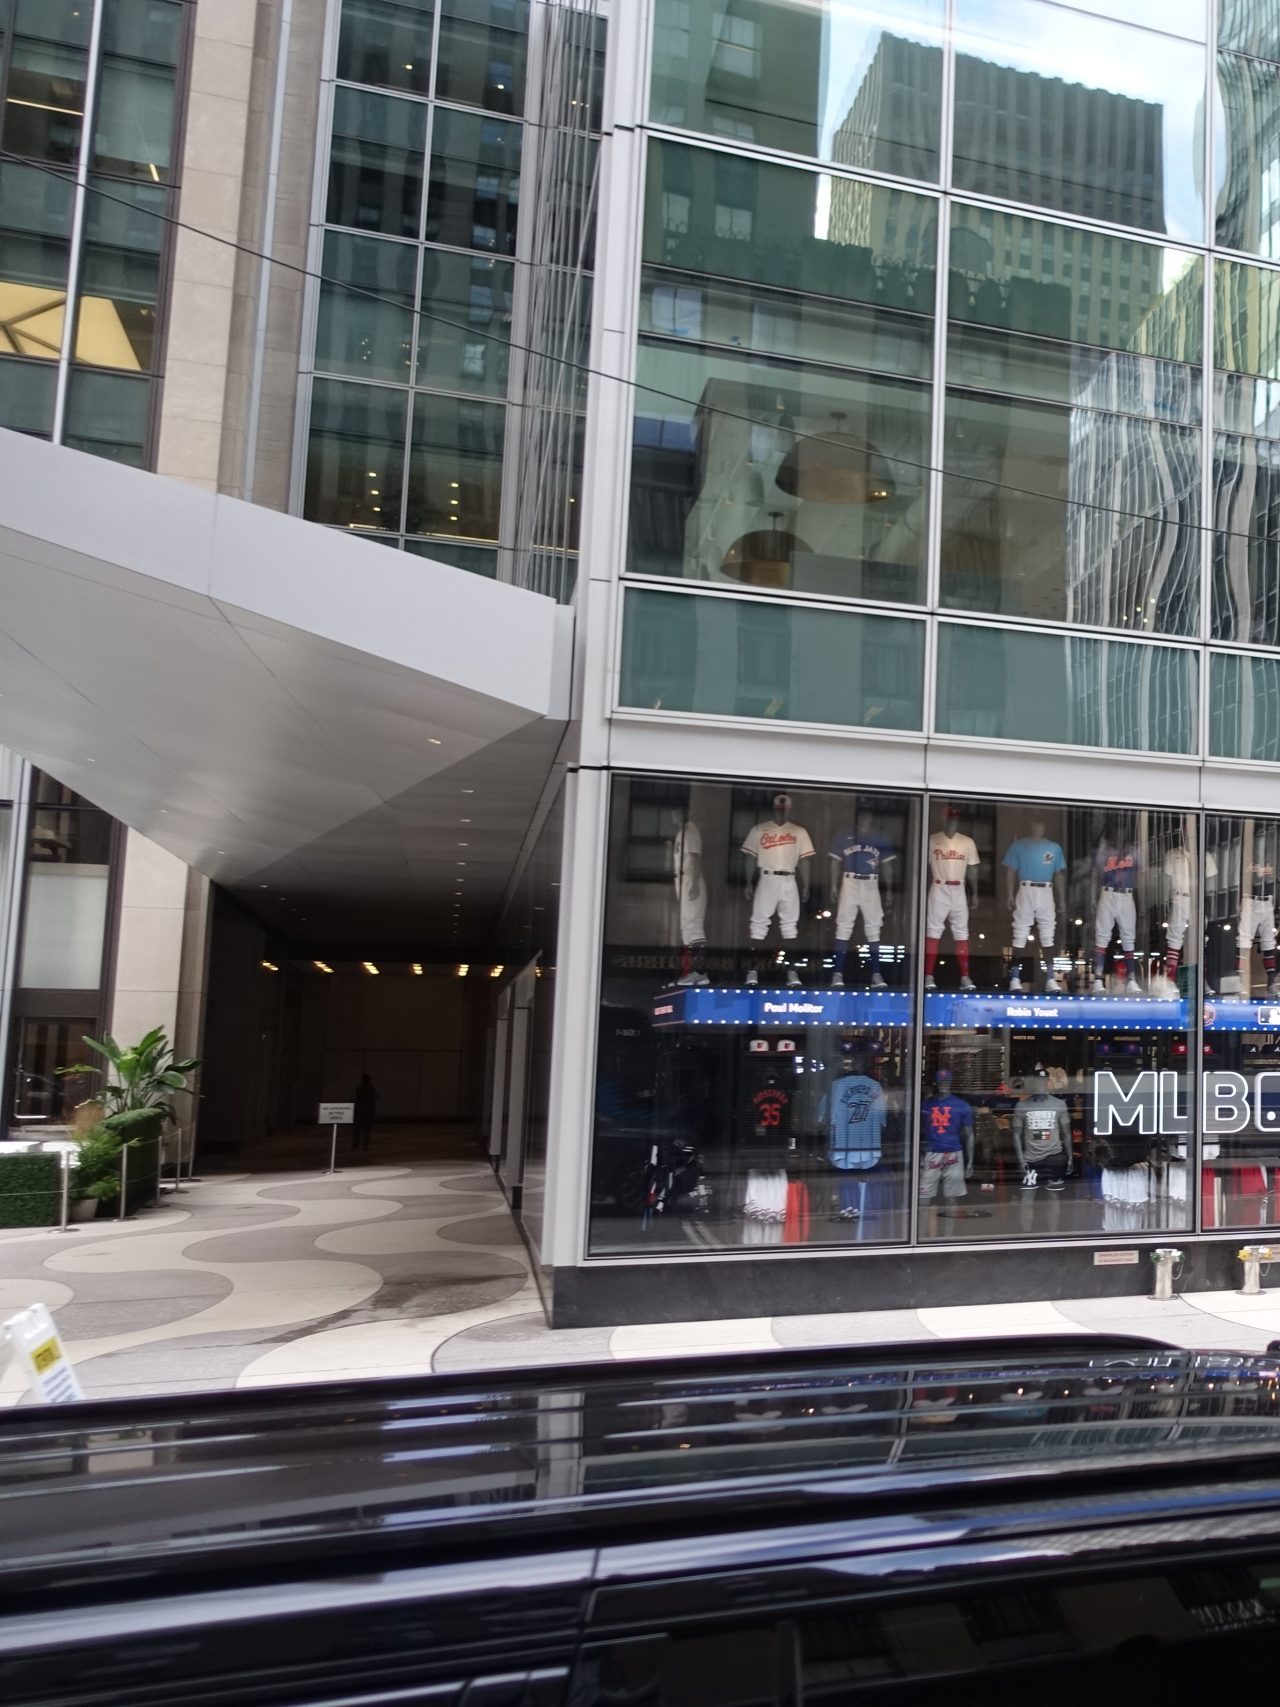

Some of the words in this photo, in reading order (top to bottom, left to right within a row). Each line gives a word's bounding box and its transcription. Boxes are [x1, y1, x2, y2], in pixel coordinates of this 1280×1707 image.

[843, 845, 861, 856] BLUE
[865, 845, 880, 857] JAYS
[764, 1002, 787, 1013] Paul
[788, 1003, 824, 1013] Molitor
[1006, 1007, 1032, 1017] Robin
[1034, 1008, 1059, 1017] Yount
[1093, 1070, 1251, 1135] MLB
[760, 1103, 781, 1126] 35
[848, 1100, 871, 1124] 27
[1026, 1111, 1057, 1120] SUBWAY
[1028, 1119, 1056, 1130] SERIES
